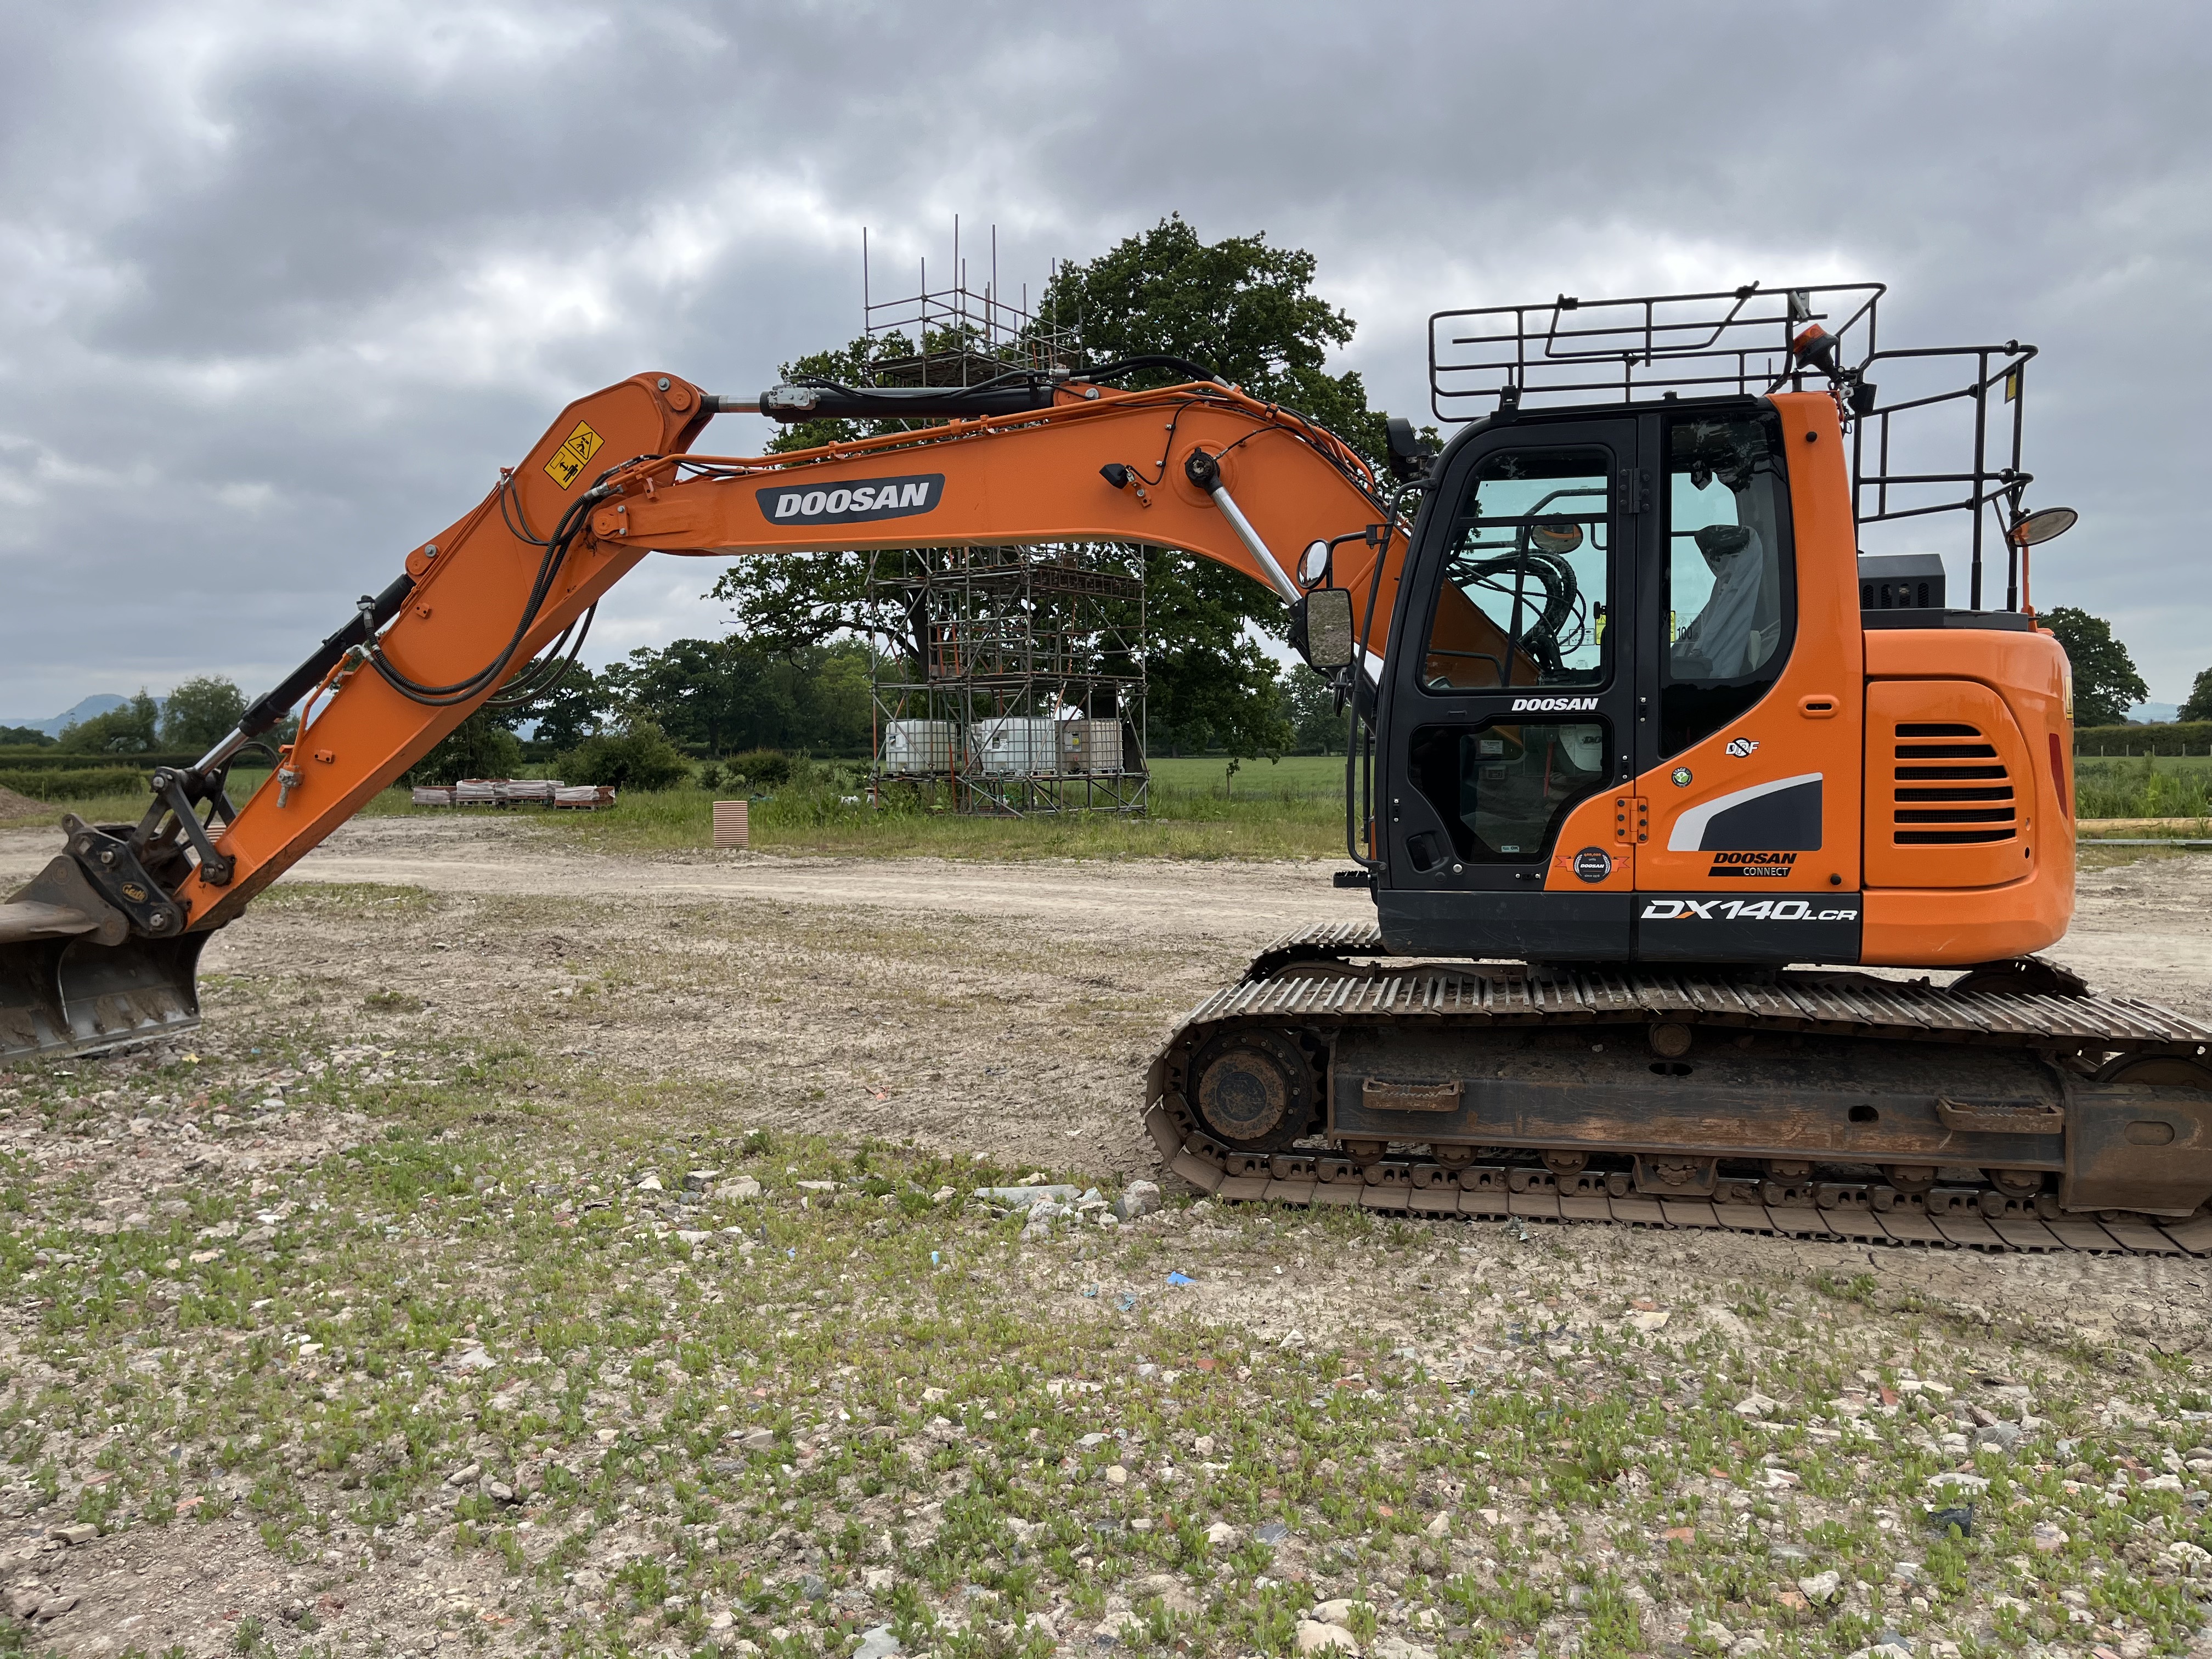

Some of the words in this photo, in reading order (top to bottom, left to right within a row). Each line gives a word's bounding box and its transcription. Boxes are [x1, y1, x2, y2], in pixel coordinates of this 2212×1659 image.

[775, 482, 929, 518] DOOSAN
[1677, 626, 1692, 640] 100
[1511, 698, 1599, 711] DOOSAN
[1725, 742, 1759, 754] DPF
[1713, 853, 1797, 864] DOOSAN
[1743, 867, 1788, 876] CONNECT
